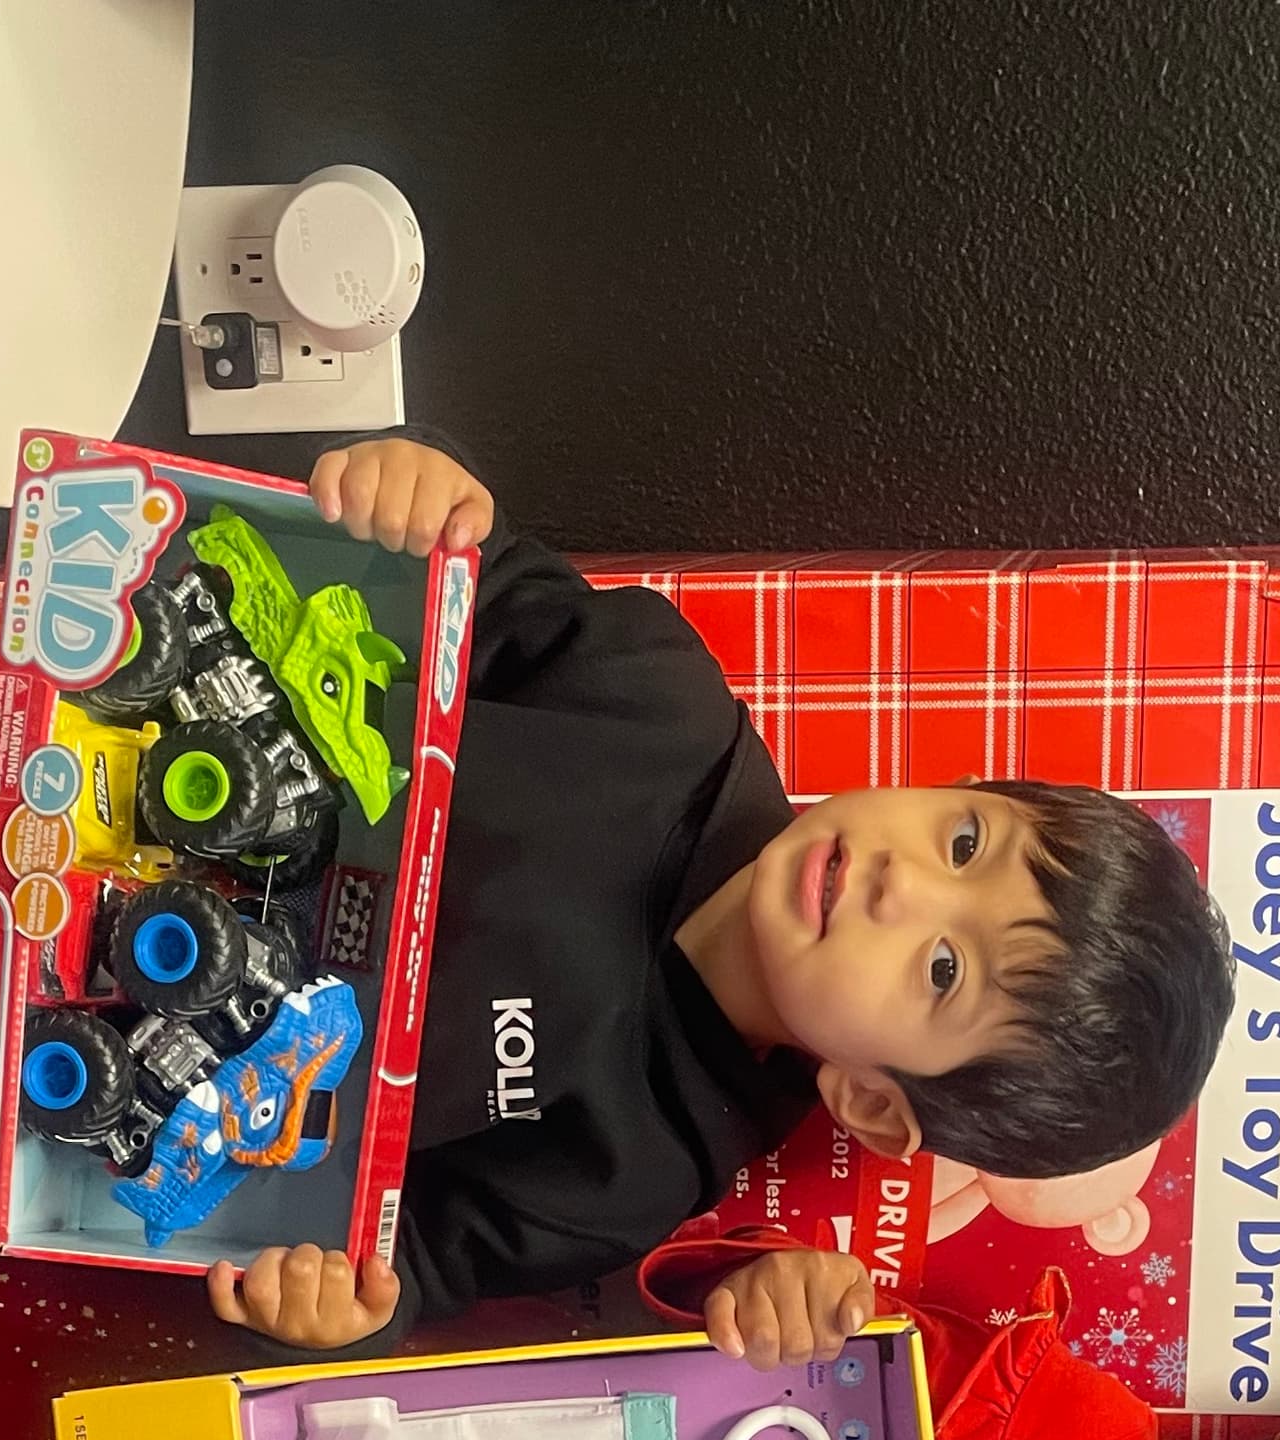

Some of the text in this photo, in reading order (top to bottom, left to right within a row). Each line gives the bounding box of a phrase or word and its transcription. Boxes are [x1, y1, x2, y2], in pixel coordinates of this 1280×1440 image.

[30, 443, 47, 467] 3+
[9, 485, 45, 653] Connection
[38, 478, 135, 671] KID
[441, 567, 466, 713] KID
[5, 710, 25, 789] WARNING:
[31, 759, 44, 800] PIECES
[43, 771, 66, 793] 7
[20, 811, 37, 874] CHANGE
[47, 822, 61, 870] SWITCH
[26, 880, 39, 933] POWERED
[36, 883, 49, 933] FRICTION
[406, 808, 441, 1033] Monster Truck
[831, 1127, 849, 1179] 2012
[765, 1179, 787, 1218] less
[870, 1179, 911, 1288] DRIVE
